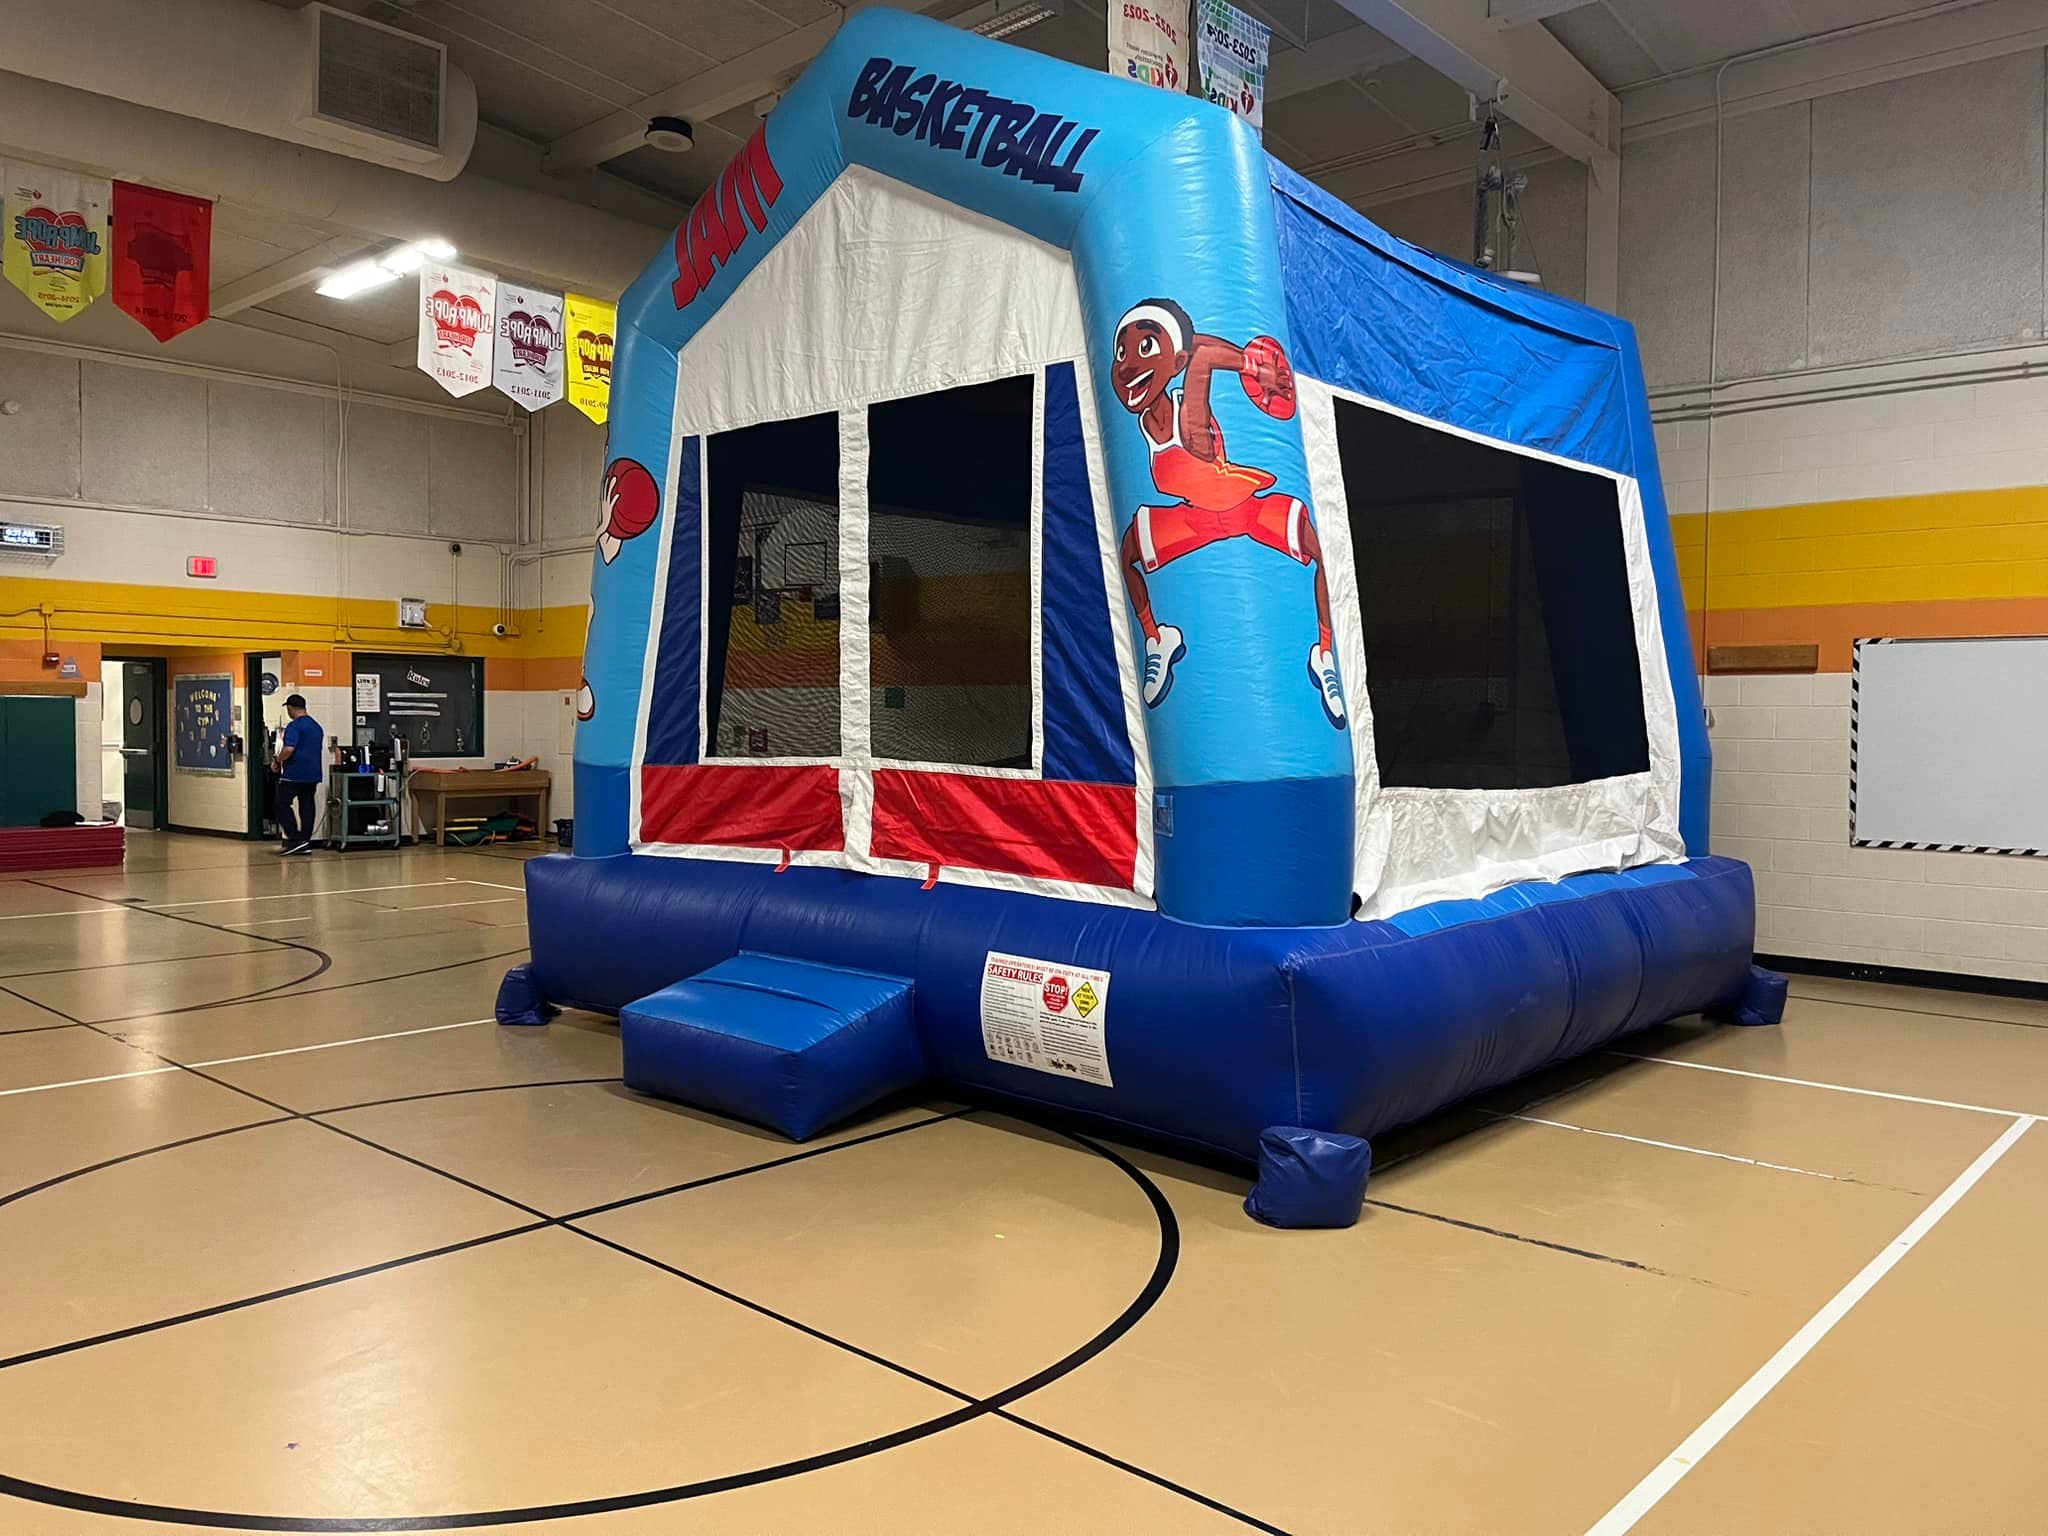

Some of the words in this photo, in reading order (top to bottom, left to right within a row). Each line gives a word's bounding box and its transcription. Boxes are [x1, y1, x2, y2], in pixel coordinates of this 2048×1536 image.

[847, 57, 1100, 193] BASKETBALL
[672, 122, 784, 310] JAM
[407, 670, 430, 687] Rules
[189, 689, 217, 702] WELCOME
[988, 964, 1017, 979] SAFETY
[1018, 970, 1043, 983] RULES
